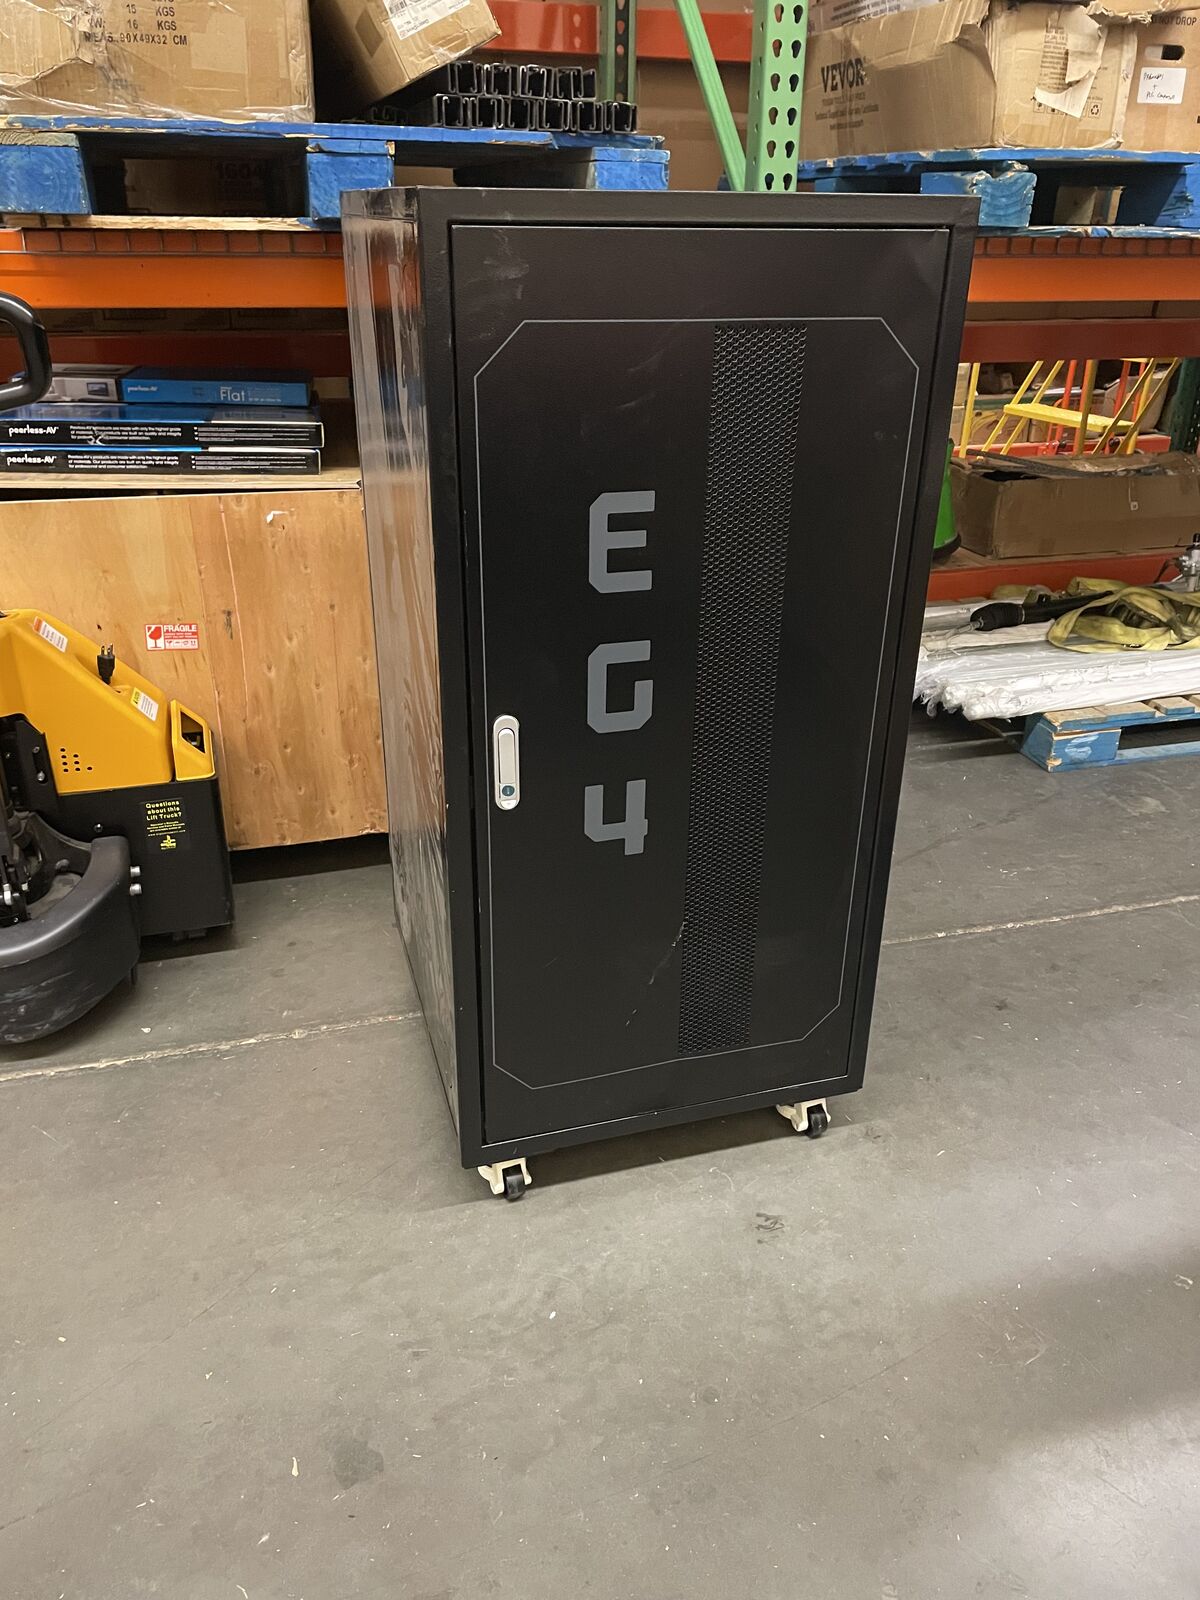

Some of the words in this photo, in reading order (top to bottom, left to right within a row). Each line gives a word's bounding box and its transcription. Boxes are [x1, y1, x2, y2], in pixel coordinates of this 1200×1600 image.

[156, 6, 175, 17] KGS
[127, 19, 138, 29] 16
[157, 20, 177, 31] KGS
[1176, 16, 1197, 26] DROP
[173, 35, 187, 45] CM
[820, 57, 865, 93] VEVOR
[220, 389, 245, 401] Flat
[164, 624, 197, 632] FRAGILE
